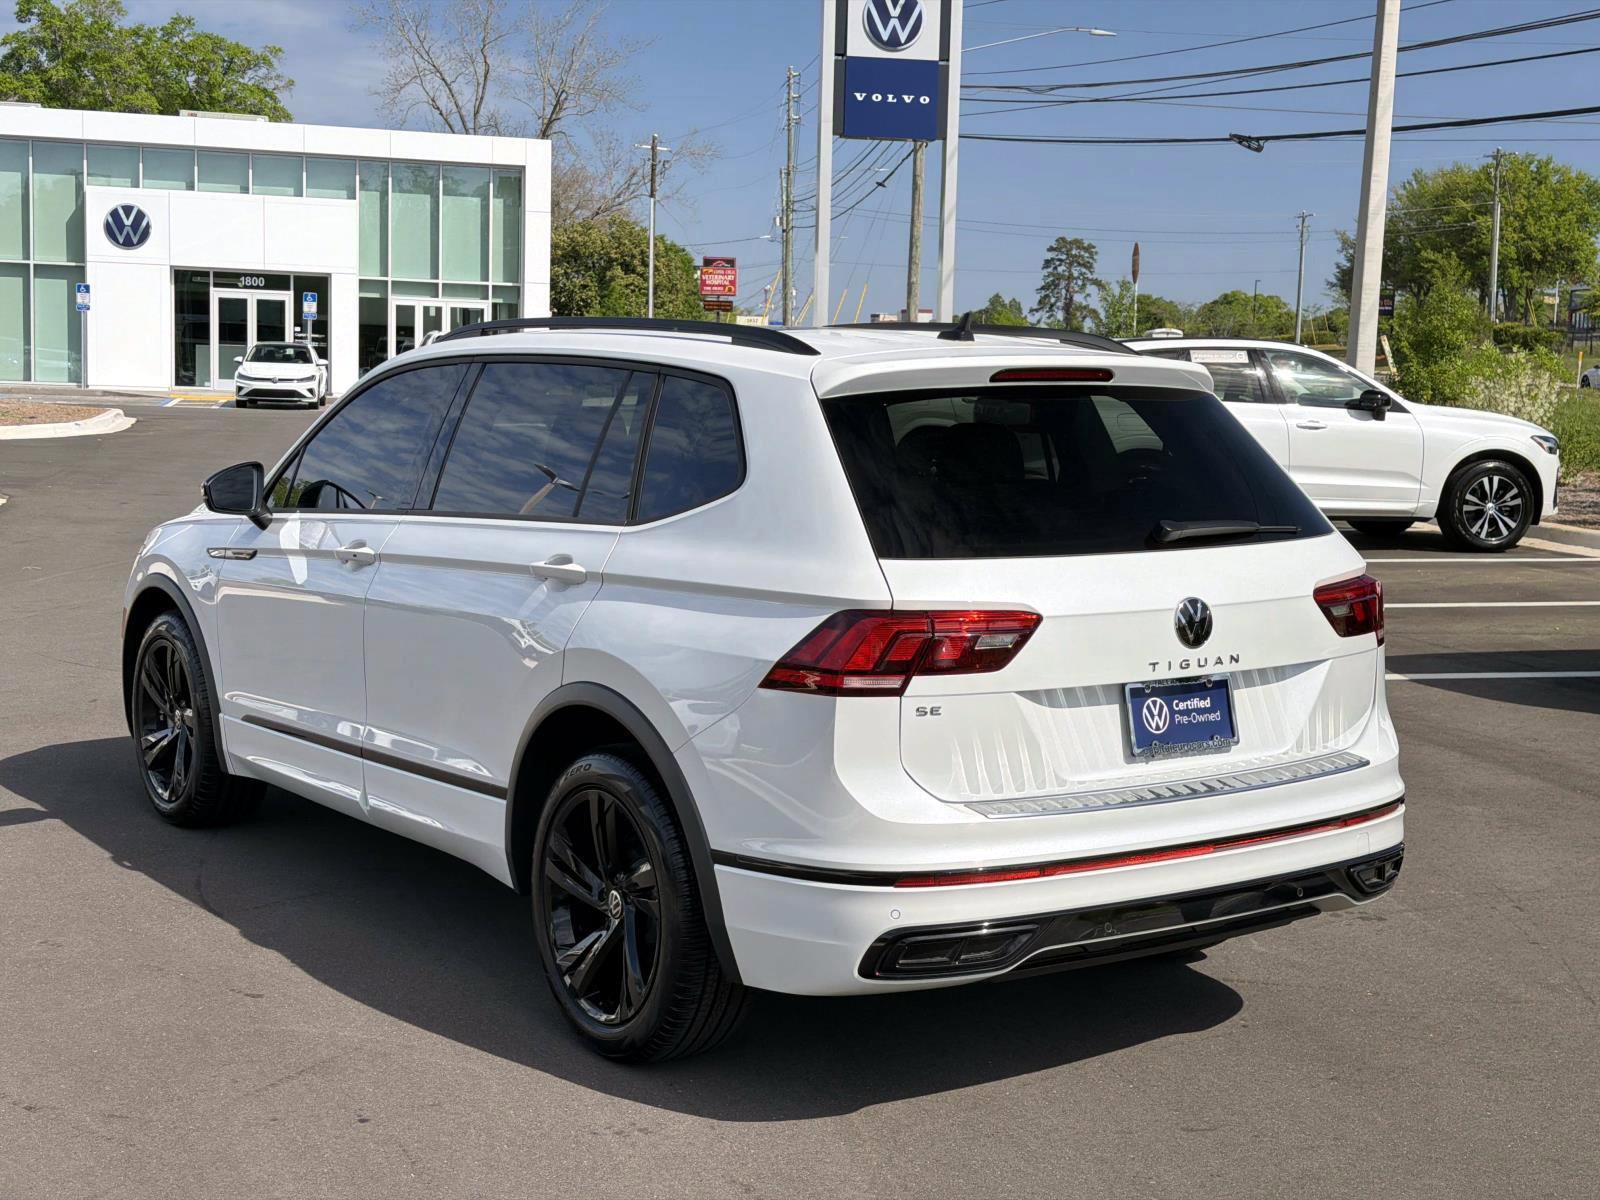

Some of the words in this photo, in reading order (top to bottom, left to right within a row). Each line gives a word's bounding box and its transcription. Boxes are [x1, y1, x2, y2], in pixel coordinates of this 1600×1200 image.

[854, 92, 930, 104] VOLVO
[240, 276, 265, 287] 1800
[1149, 654, 1240, 672] TIGUAN
[1173, 697, 1211, 711] Certified
[916, 706, 942, 717] SE
[1174, 710, 1221, 725] Pre-Owned
